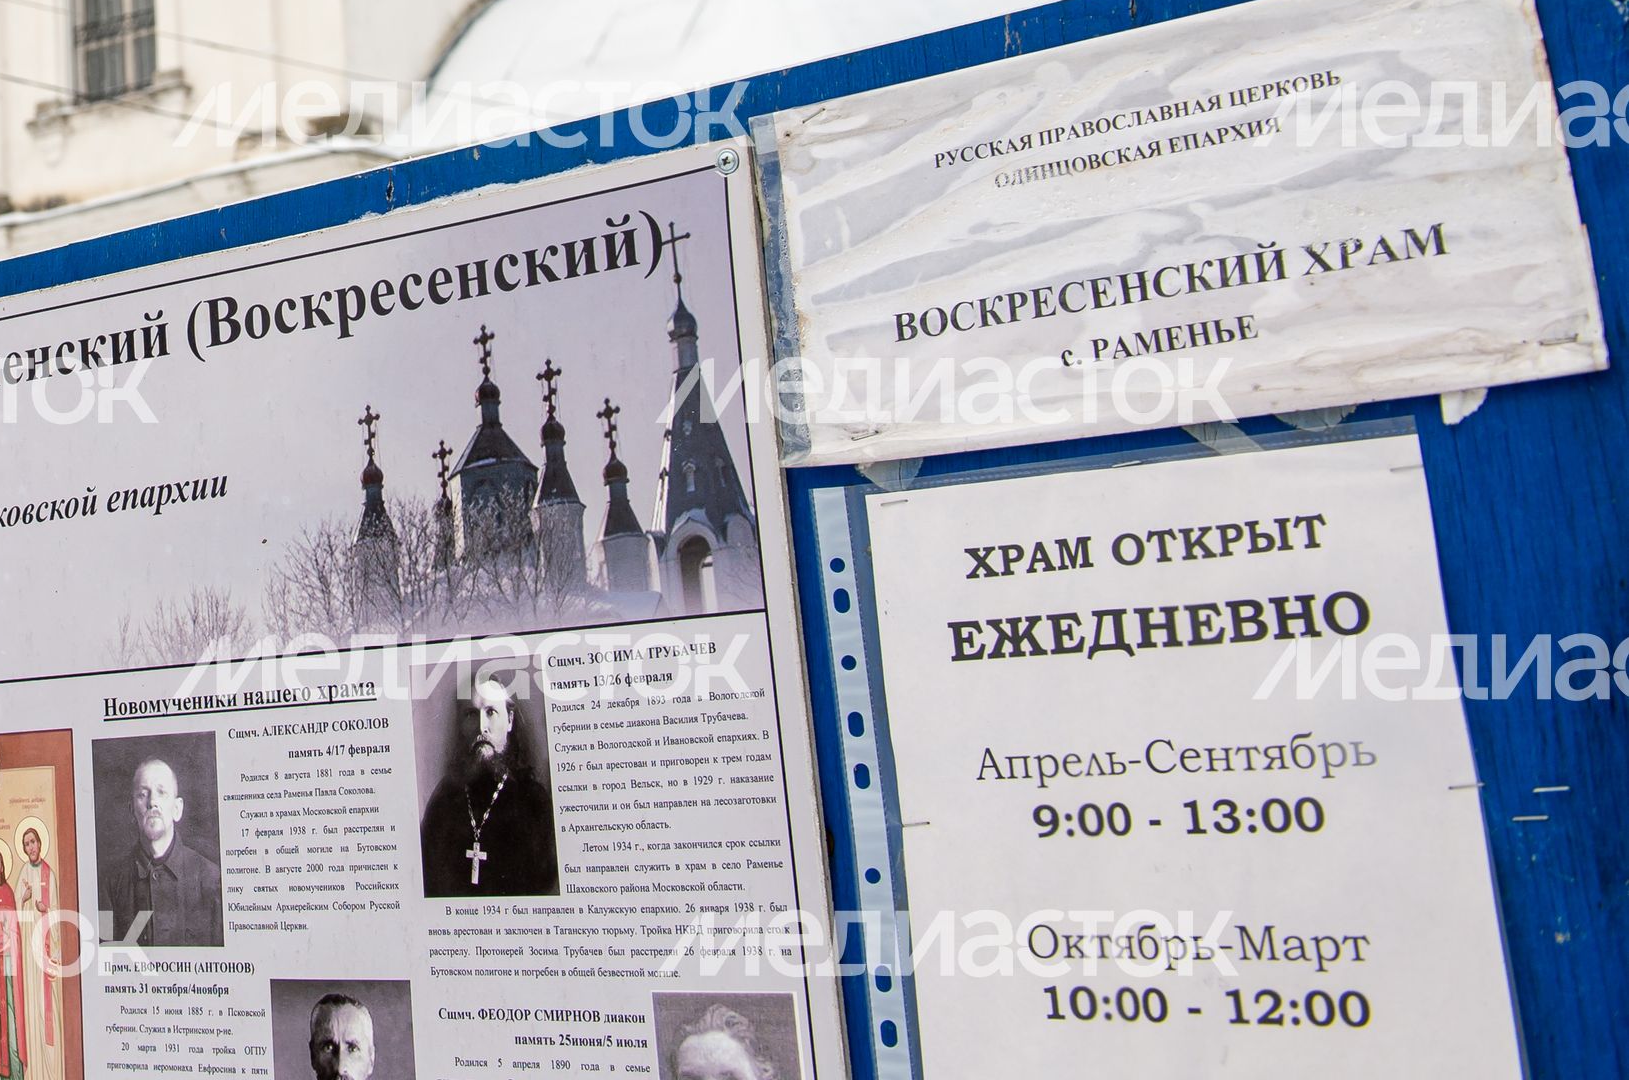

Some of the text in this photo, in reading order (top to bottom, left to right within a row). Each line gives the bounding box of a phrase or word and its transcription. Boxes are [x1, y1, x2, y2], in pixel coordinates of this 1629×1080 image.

[934, 70, 1340, 168] РУССКАЯ ПРАВОСЛАВНАЯ ЦЕРКОВЬ
[994, 117, 1280, 187] ОДИНЦОВСКАЯ ЕПАРХИЯ
[186, 210, 664, 362] (Воскресенский)
[894, 222, 1450, 340] ВОСКРЕСЕНСКИЙ ХРАМ
[1092, 315, 1258, 361] РАМЕНЬЕ
[106, 476, 227, 515] епархии
[964, 515, 1325, 579] ХРАМ ОТКРЫТ
[948, 592, 1369, 660] ЕЖЕДНЕВНО
[547, 641, 716, 668] Сщмч. ЗОСИМА ТРУБАЧЕВ
[550, 672, 673, 690] память 13/26 февраля
[103, 681, 377, 717] Новомученики нашего храма
[227, 717, 389, 739] Сщмч. АЛЕКСАНДР СОКОЛОВ
[553, 711, 748, 734] губернии в семье диакона Василия Трубачева.
[288, 744, 390, 758] память 4/17 февраля
[979, 733, 1376, 787] Апрель-Сентябрь
[239, 805, 379, 821] Служил в храмах Московской епархии
[559, 803, 609, 815] ужесточили
[619, 802, 631, 810] он
[632, 799, 651, 809] был
[653, 799, 698, 811] направлен
[700, 798, 711, 807] на
[713, 796, 777, 806] лесозаготовки
[560, 819, 671, 834] в Архангельскую область.
[1032, 802, 1132, 838] 9:00
[1183, 797, 1324, 834] 13:00
[227, 881, 399, 895] лику святых новомучеников Российских
[565, 880, 745, 895] Шаховского района Московской области.
[227, 900, 400, 913] Юбилейным Архиерейским Собором Русской
[228, 920, 308, 932] Православной Церкви.
[1028, 924, 1368, 972] Октябрь-Март
[134, 961, 191, 973] ЕВФРОСИН
[194, 961, 255, 975] (АНТОНОВ)
[104, 982, 229, 997] память 31 октября/4ноября
[438, 1007, 645, 1024] Сщмч. ФЕОДОР СМИРНОВ диакон
[1044, 985, 1168, 1022] 10:00
[1226, 989, 1370, 1027] 12:00
[121, 1041, 267, 1056] 20 марта 1931 года тройка ОГПУ
[514, 1036, 556, 1045] память
[615, 1038, 648, 1048] июля
